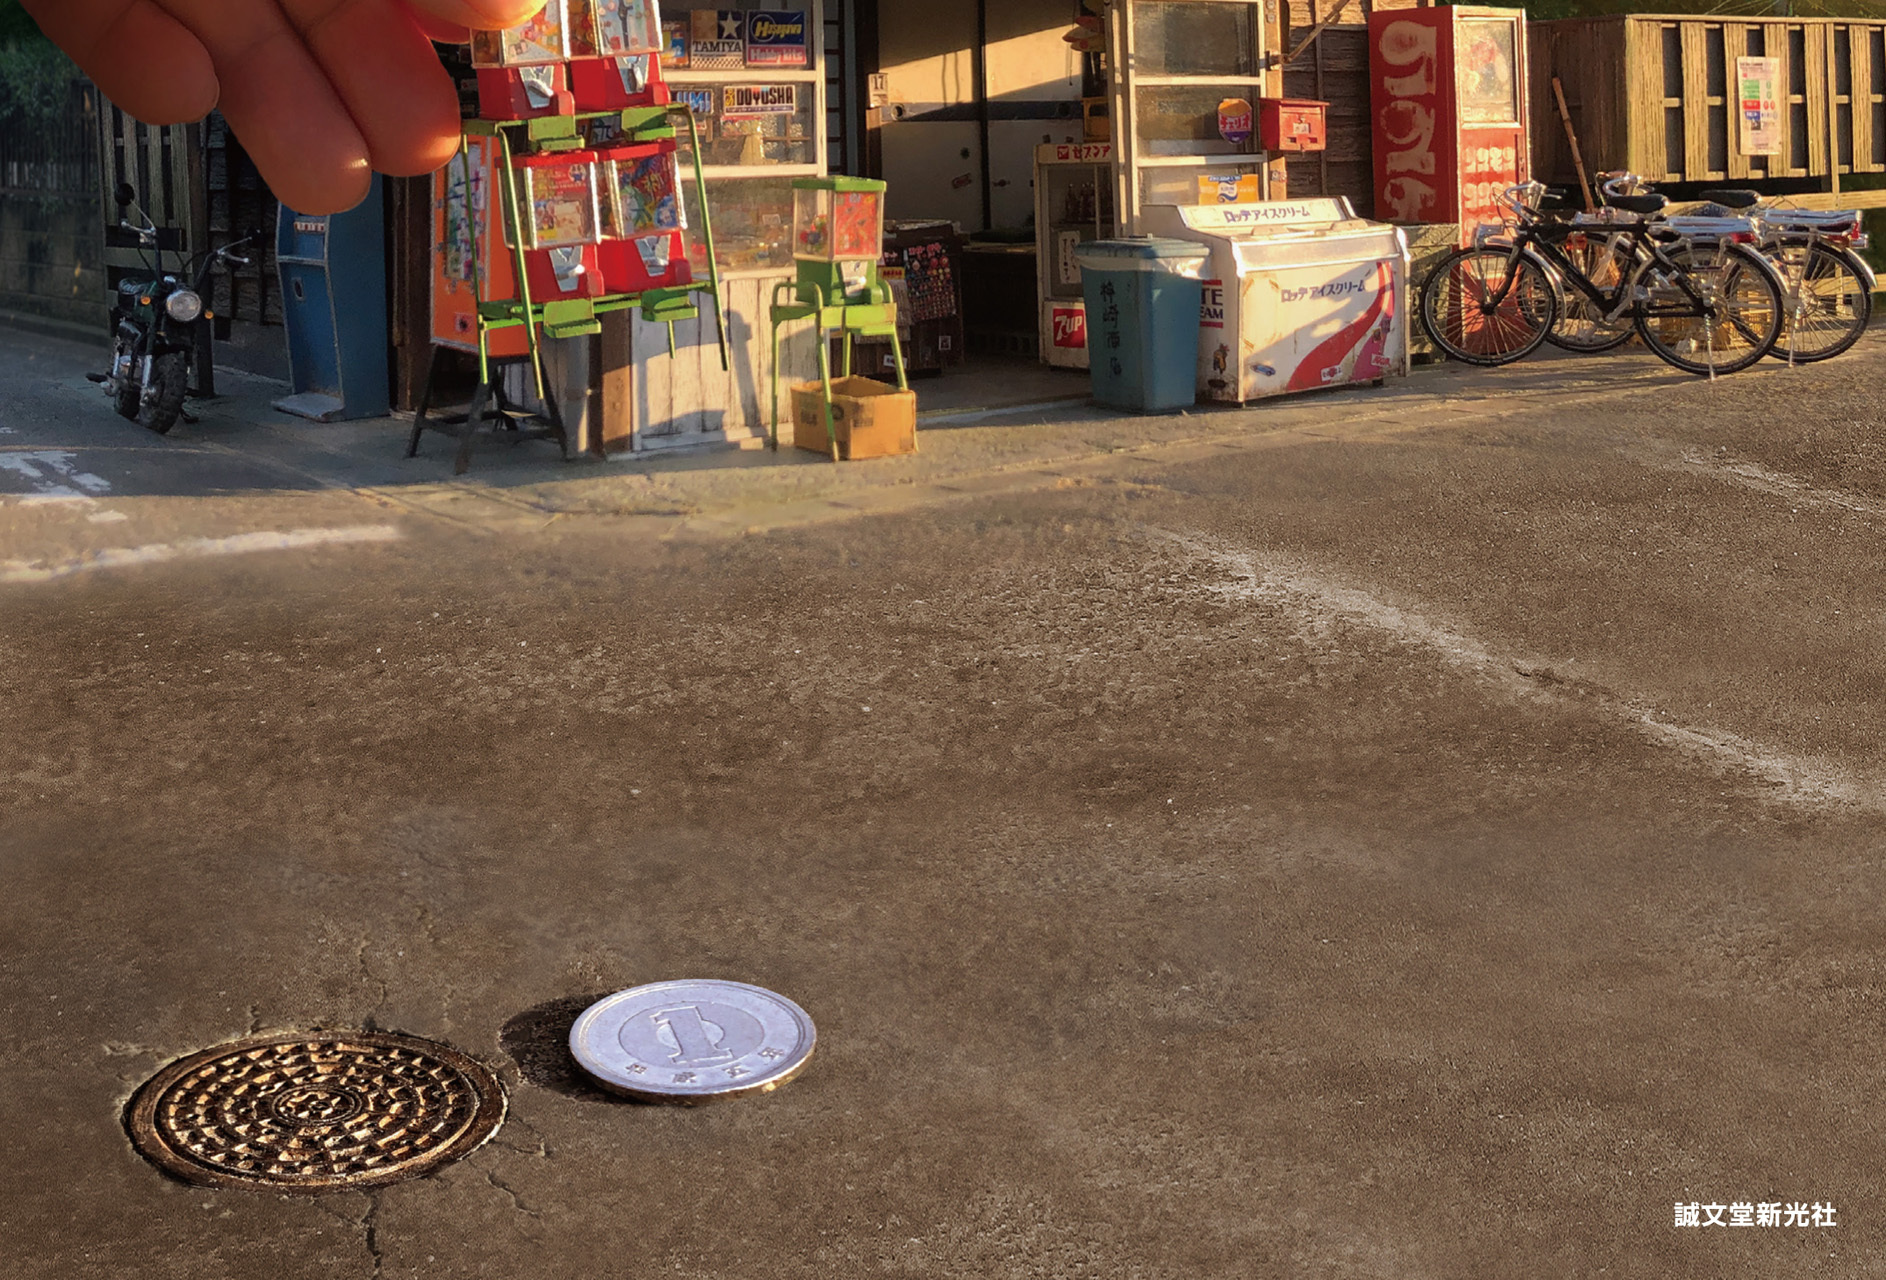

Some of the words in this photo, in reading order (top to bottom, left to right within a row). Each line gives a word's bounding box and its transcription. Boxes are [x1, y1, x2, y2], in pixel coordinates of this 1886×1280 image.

[692, 40, 742, 52] TAMIYA
[872, 75, 884, 90] 17
[736, 86, 794, 105] DOYUSHA
